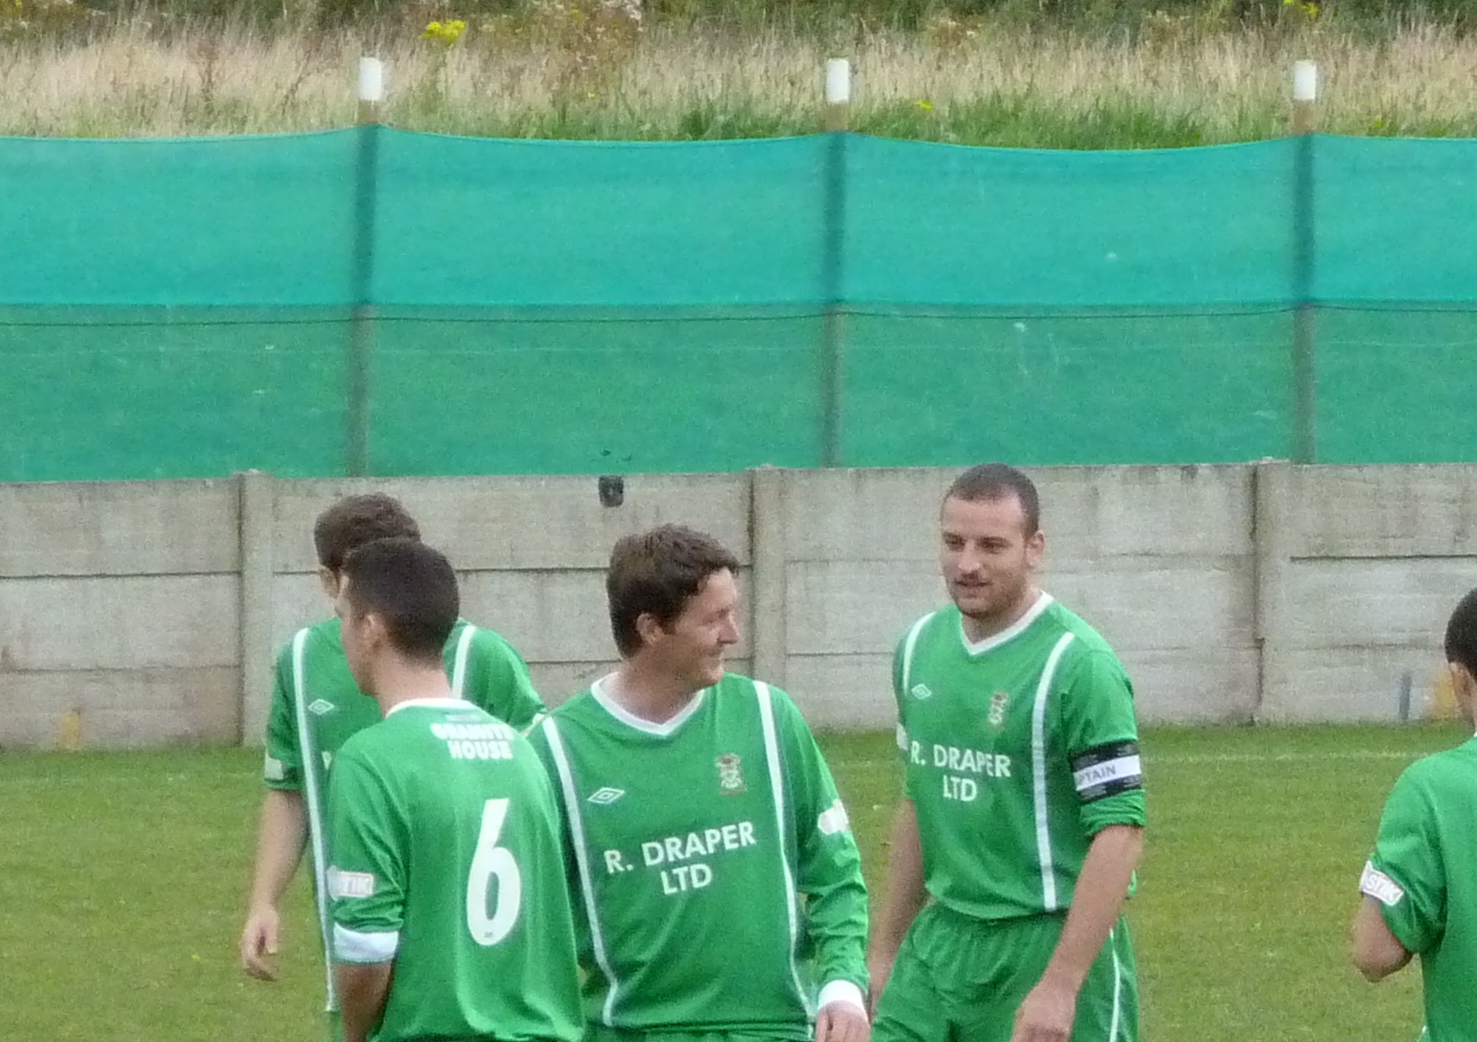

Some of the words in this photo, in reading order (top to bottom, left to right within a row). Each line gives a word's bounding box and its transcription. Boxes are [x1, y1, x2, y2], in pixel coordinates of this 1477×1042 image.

[447, 740, 514, 760] HOUSE
[911, 740, 926, 765] R.
[934, 744, 1012, 777] DRAPER
[943, 774, 977, 802] LTD
[1078, 764, 1117, 785] PTAIN
[603, 849, 634, 874] R.
[641, 821, 756, 867] DRAPER
[466, 798, 521, 945] 6
[660, 863, 712, 895] LTD
